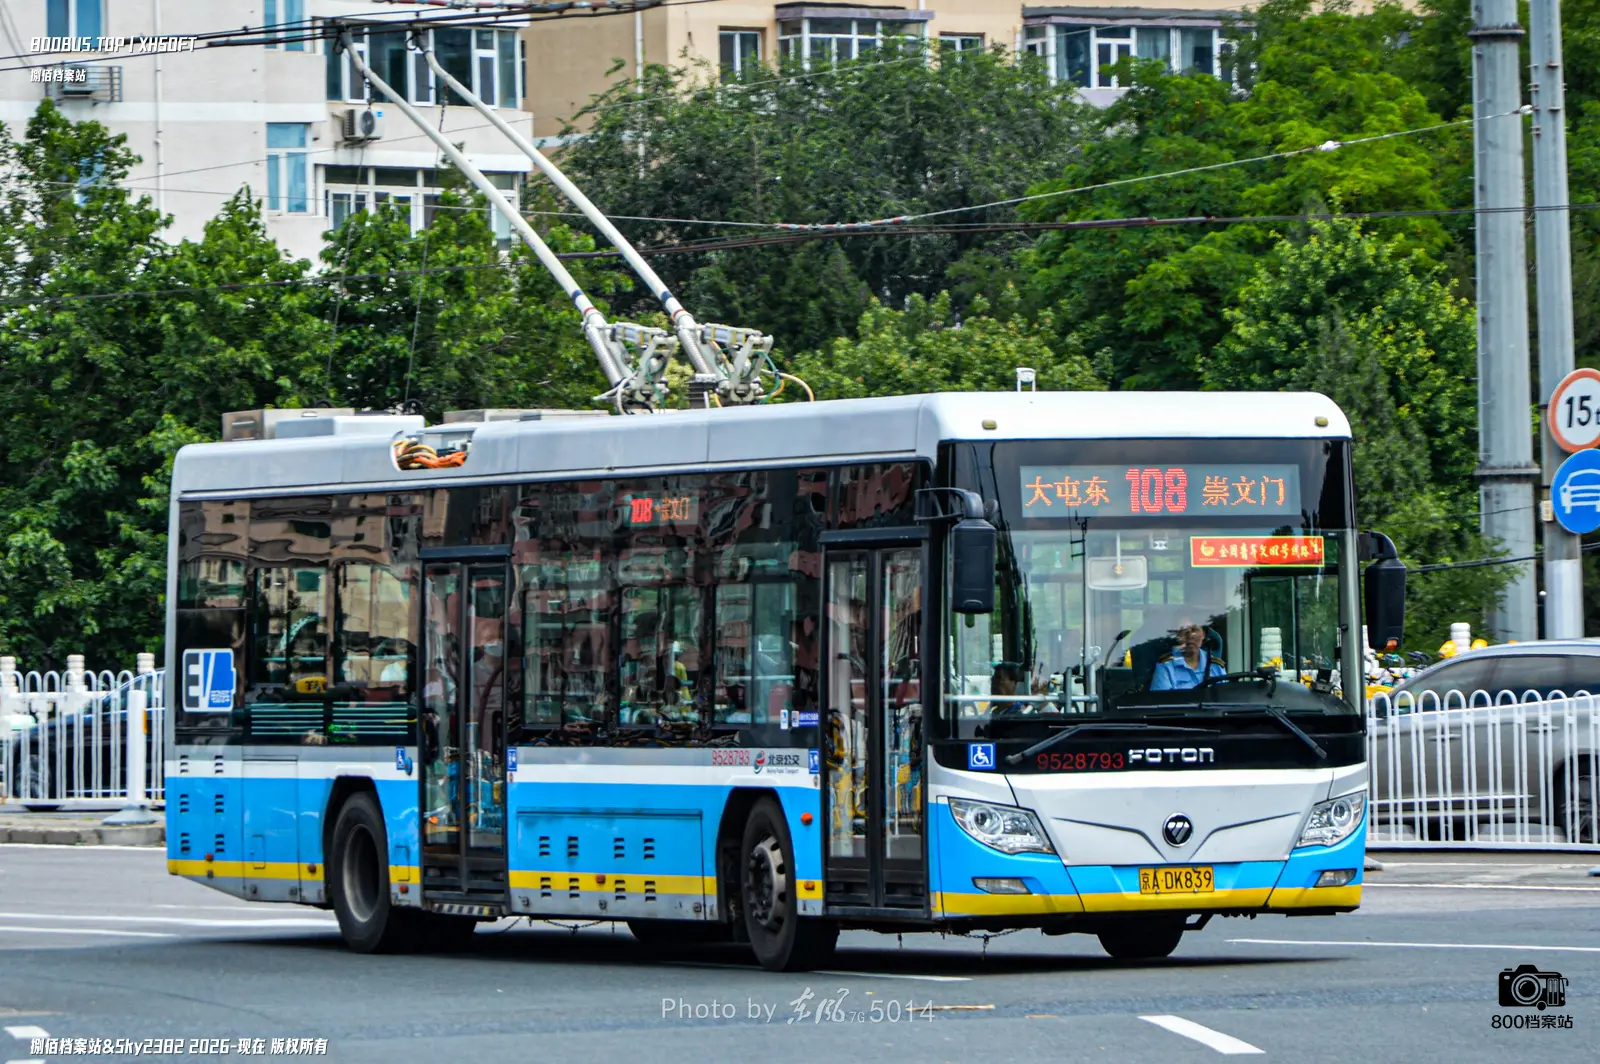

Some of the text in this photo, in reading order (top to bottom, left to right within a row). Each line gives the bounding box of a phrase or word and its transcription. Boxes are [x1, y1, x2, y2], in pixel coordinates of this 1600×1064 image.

[1025, 468, 1285, 513] 大屯东 108 崇文门
[631, 498, 653, 523] 108
[712, 750, 750, 766] 9528793
[768, 754, 800, 766] 北京公交
[1037, 752, 1124, 770] 9528793
[1128, 748, 1214, 763] FOTON
